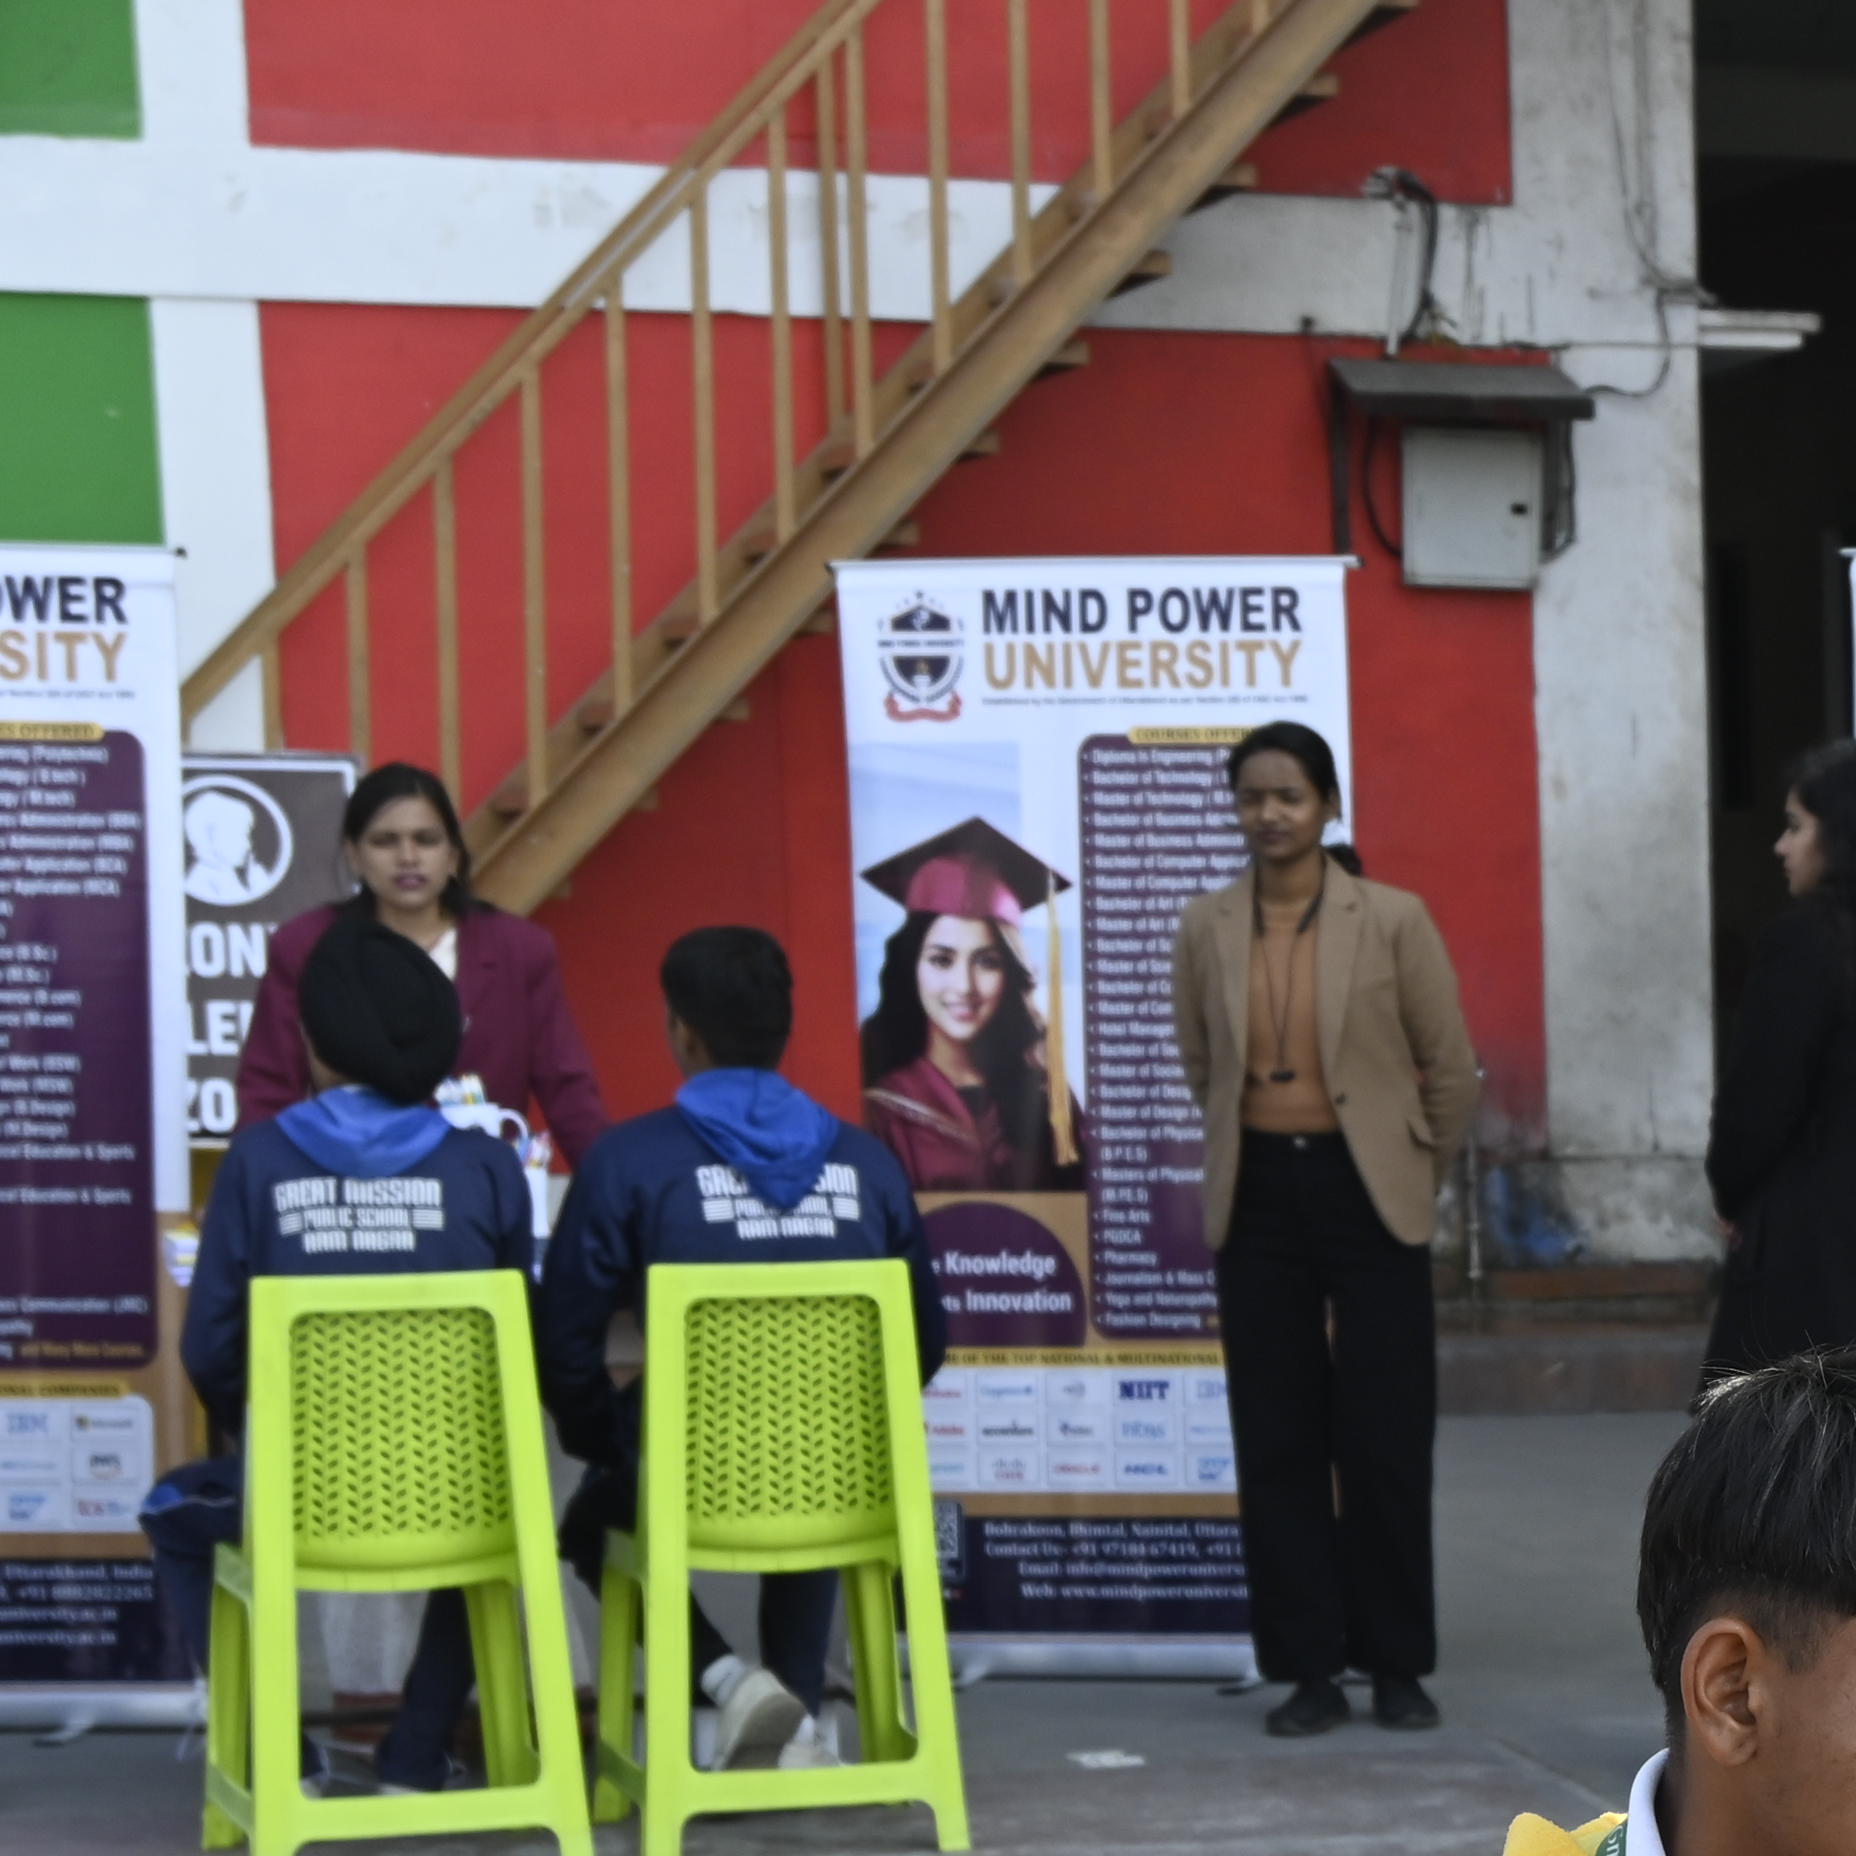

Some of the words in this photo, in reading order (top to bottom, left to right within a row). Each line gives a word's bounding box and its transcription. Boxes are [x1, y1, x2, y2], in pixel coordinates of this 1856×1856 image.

[0, 575, 128, 624] WER
[981, 589, 1107, 635] MIND
[1126, 587, 1303, 634] POWER
[982, 640, 1303, 690] UNIVERSITY
[945, 1251, 1056, 1280] Knowledge
[966, 1289, 1072, 1312] Innovation
